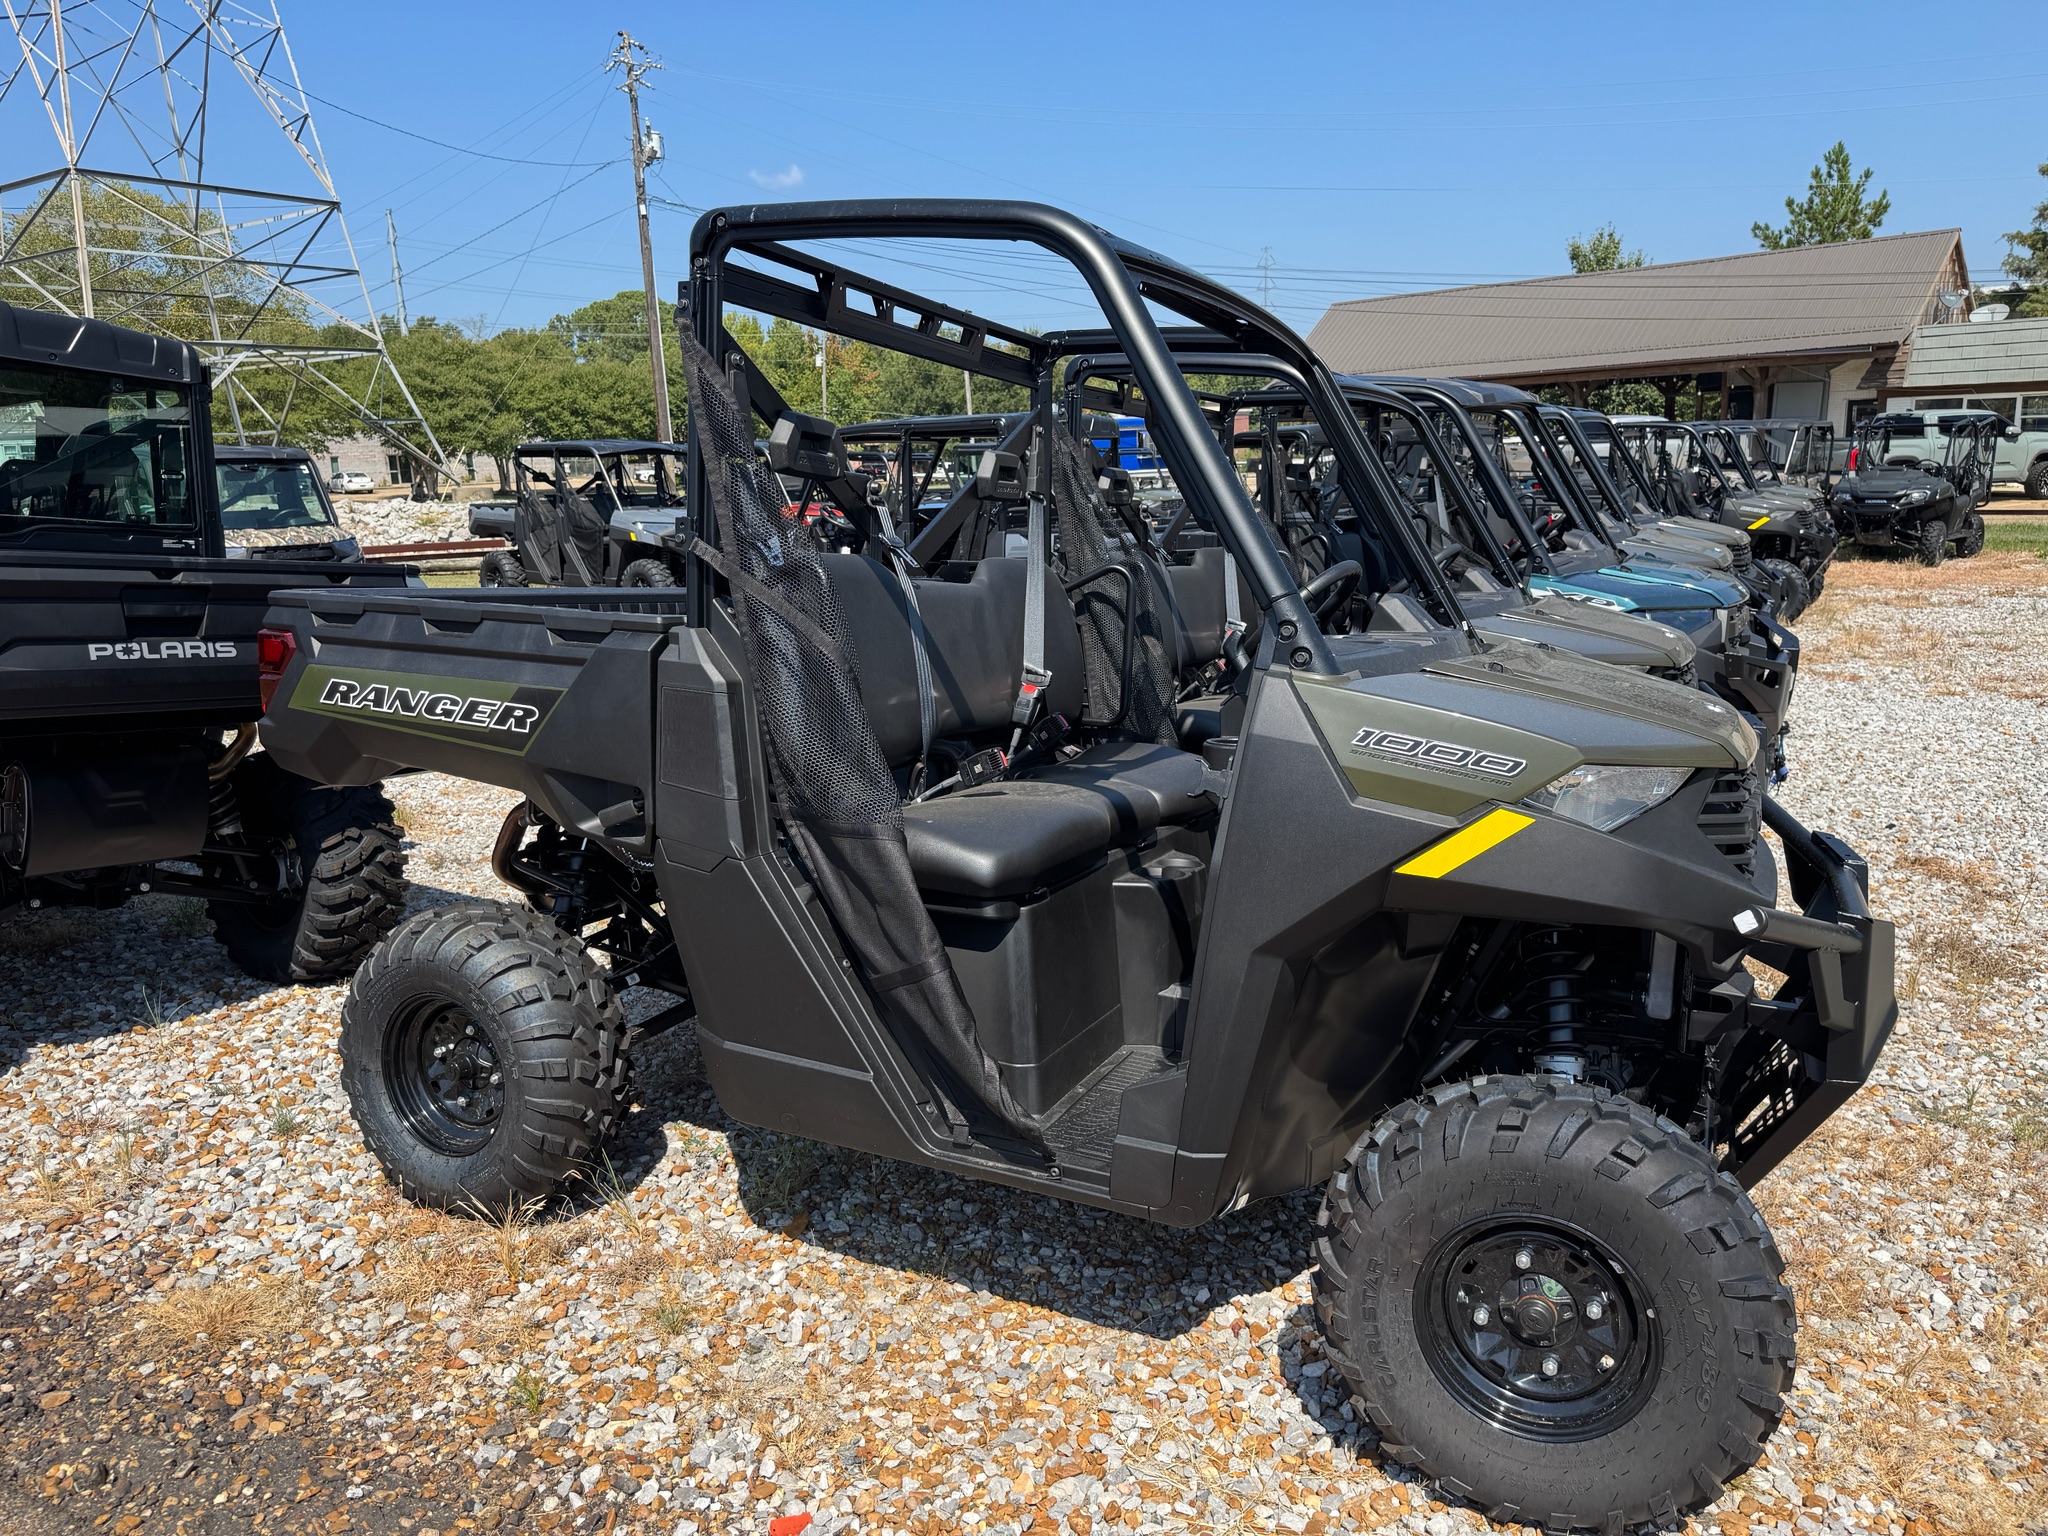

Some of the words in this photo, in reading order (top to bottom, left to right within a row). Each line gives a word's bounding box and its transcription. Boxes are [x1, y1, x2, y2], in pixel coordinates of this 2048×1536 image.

[88, 641, 238, 661] POLARIS
[319, 678, 539, 733] RANGER
[1349, 749, 1403, 763] SINGLE
[1404, 759, 1479, 780] OVERHEAD
[1480, 776, 1513, 787] CAM
[1351, 726, 1527, 779] 1000
[1361, 1256, 1397, 1390] CARLSTAR
[1677, 1278, 1718, 1414] AT489
